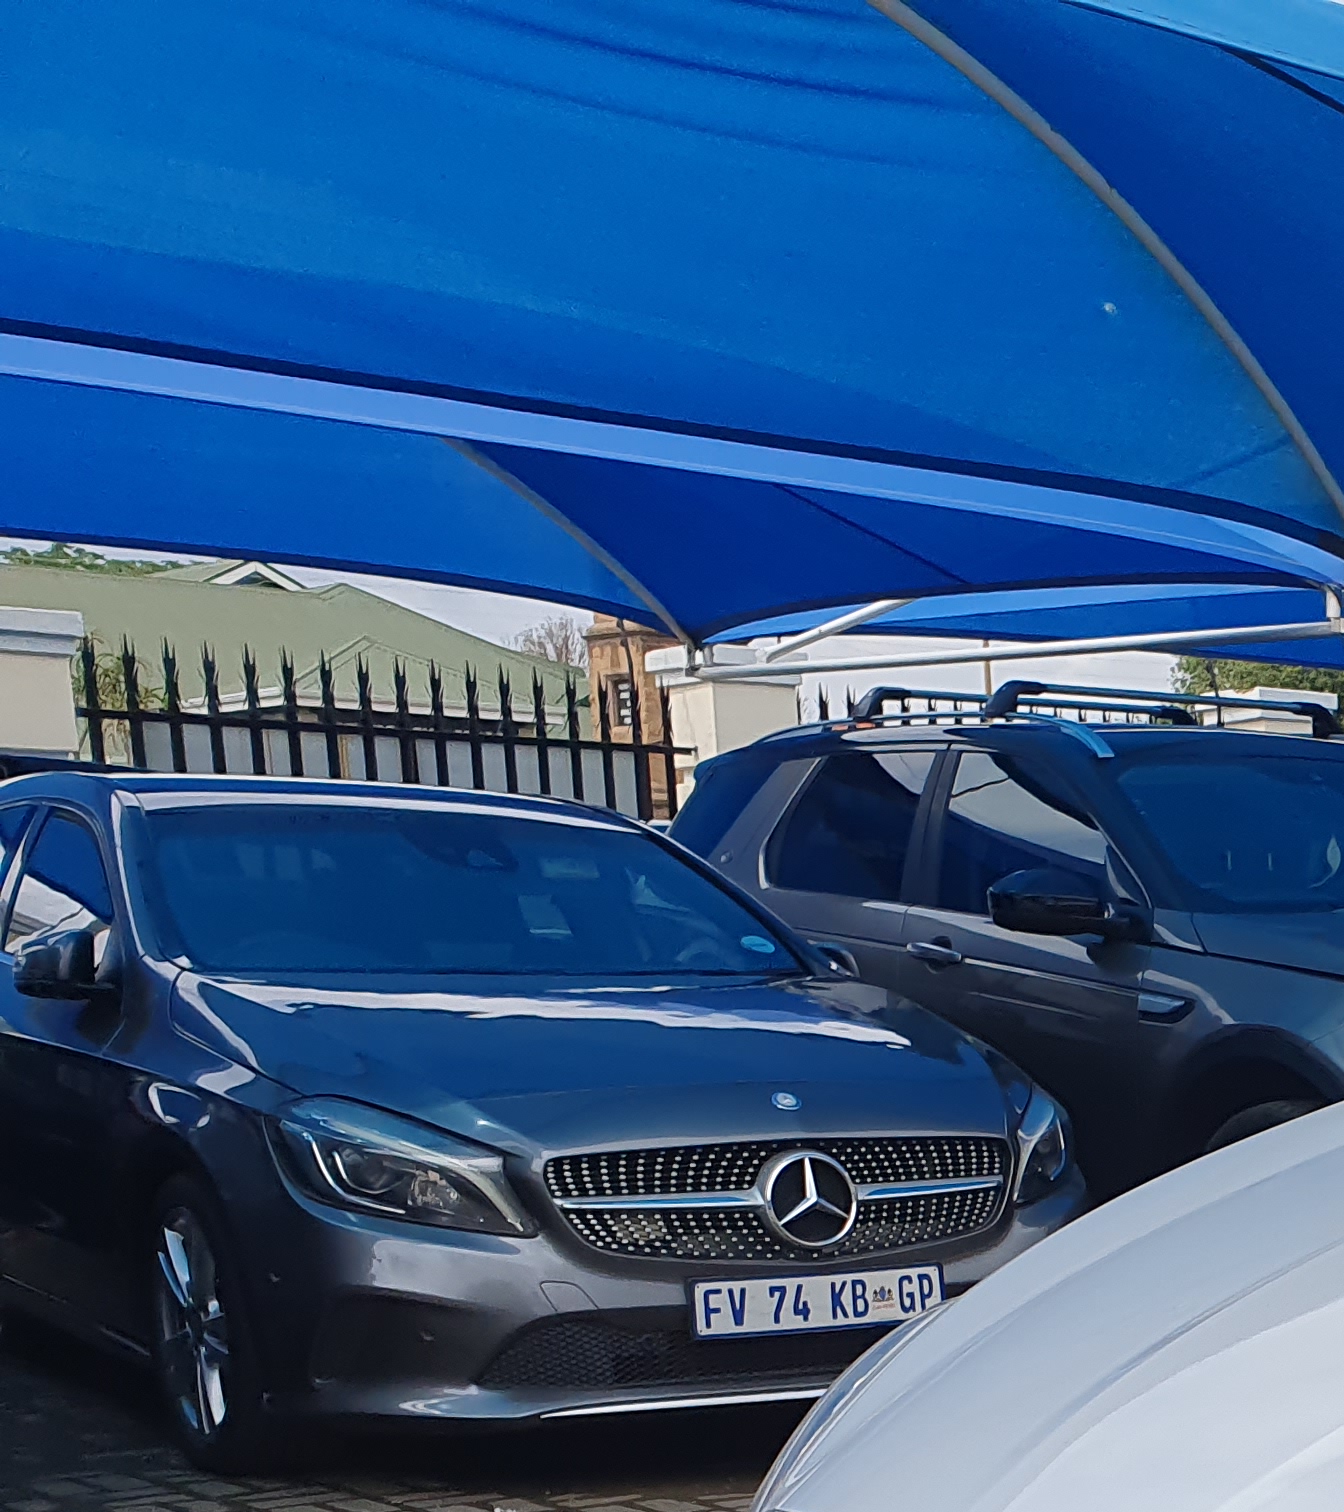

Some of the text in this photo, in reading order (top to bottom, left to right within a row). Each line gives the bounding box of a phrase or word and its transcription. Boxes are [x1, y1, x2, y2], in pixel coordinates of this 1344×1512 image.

[703, 1273, 934, 1329] FV 74 KB GP
